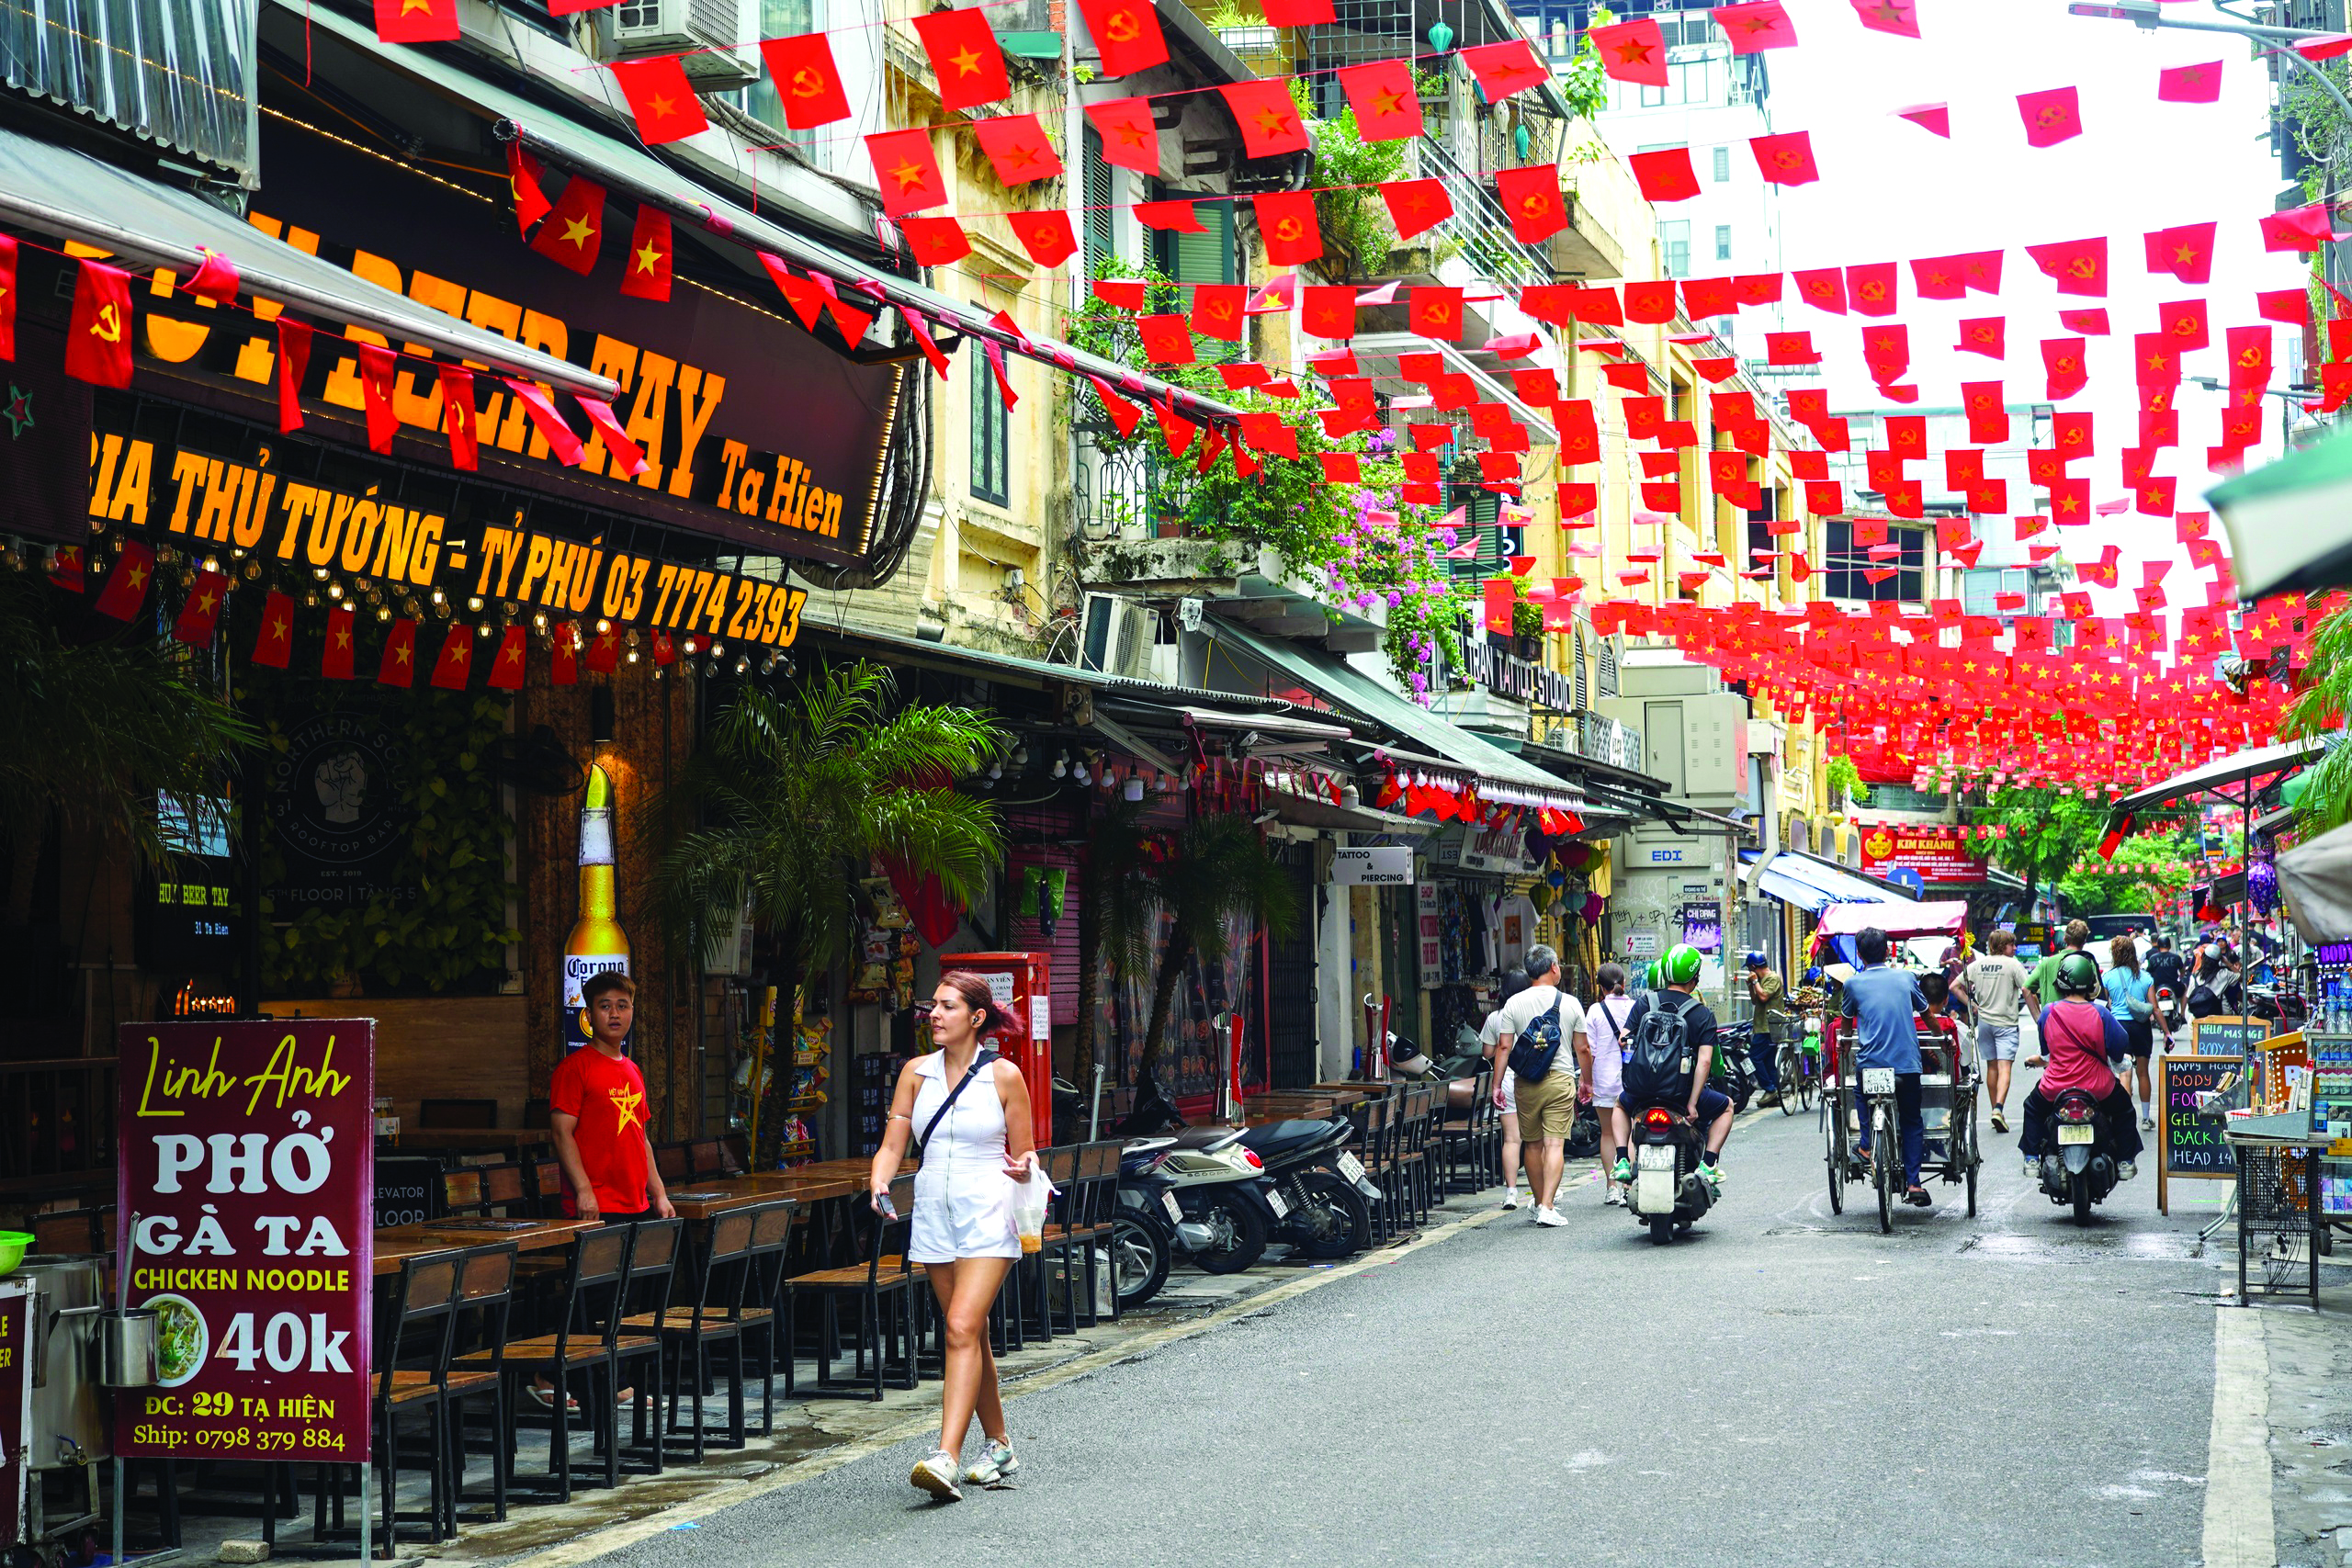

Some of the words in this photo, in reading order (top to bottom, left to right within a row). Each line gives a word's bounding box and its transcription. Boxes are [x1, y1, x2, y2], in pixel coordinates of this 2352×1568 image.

[579, 334, 726, 499] TAY
[718, 438, 765, 516] Ta
[767, 455, 843, 538] Hien
[169, 447, 277, 548] THỦ
[277, 485, 446, 587] TƯỚNG
[476, 511, 525, 597] TỶ
[517, 531, 604, 613] PHÚ
[602, 555, 651, 621] 03
[651, 564, 731, 634] 7774
[727, 580, 808, 648] 2393
[1537, 666, 1572, 713] STUDIO
[289, 822, 360, 852] ROOFTOP
[368, 820, 394, 843] BAR
[1896, 840, 1917, 849] KIM
[1918, 837, 1955, 850] KHÁNH
[1652, 851, 1682, 862] EDI
[1361, 874, 1404, 882] PIERCING
[183, 885, 208, 906] BEER
[212, 887, 229, 907] TAY
[291, 888, 344, 901] FLOOR
[568, 958, 625, 979] Corona
[2199, 1025, 2222, 1035] HELLO
[2199, 1043, 2224, 1055] BODY
[137, 1036, 237, 1117] Linh
[243, 1034, 351, 1116] Anh
[2168, 1063, 2201, 1072] HAPPY
[2172, 1075, 2212, 1087] BODY
[2171, 1112, 2199, 1126] GEL
[2174, 1131, 2213, 1145] BACK
[152, 1110, 334, 1194] PHỞ
[2174, 1149, 2211, 1165] HEAD
[135, 1203, 236, 1256] GÀ
[254, 1215, 349, 1257] TA
[134, 1268, 237, 1291] CHICKEN
[246, 1269, 349, 1292] NOODLE
[214, 1312, 354, 1373] 40k
[145, 1396, 184, 1416] ĐC:
[192, 1392, 234, 1416] 29
[241, 1398, 270, 1423] TẠ
[278, 1393, 334, 1424] HIỆN
[133, 1424, 188, 1450] Ship:
[195, 1427, 250, 1450] 0798
[256, 1431, 296, 1451] 379
[302, 1428, 345, 1452] 884
